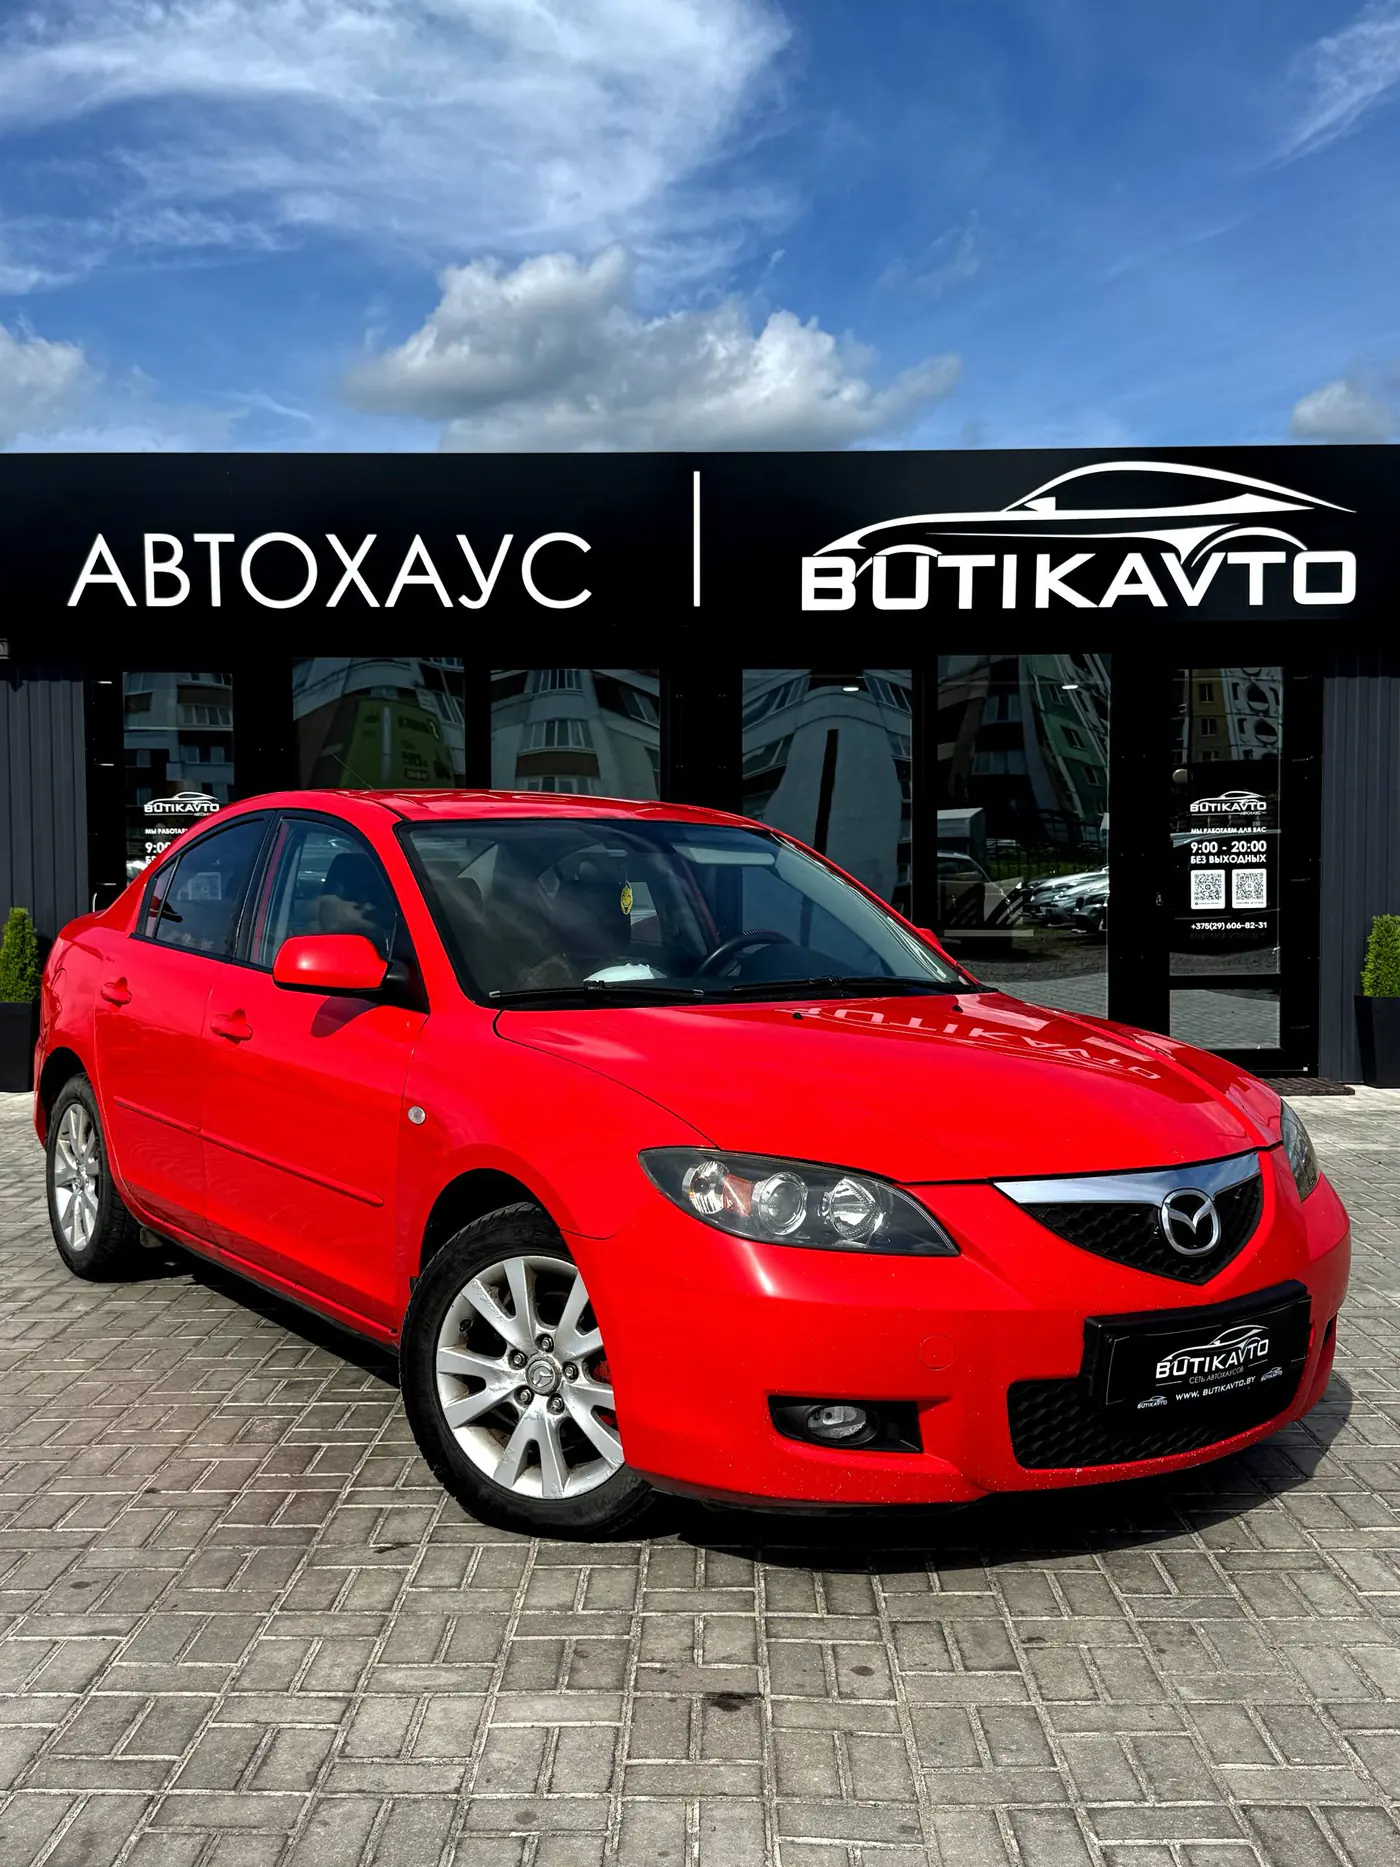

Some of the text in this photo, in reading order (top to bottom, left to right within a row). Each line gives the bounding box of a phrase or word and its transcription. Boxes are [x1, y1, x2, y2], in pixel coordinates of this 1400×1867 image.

[67, 532, 592, 609] АВТОХАУС
[801, 549, 1357, 611] BUTIKAVTO
[144, 803, 220, 813] BUTIKAVTO
[1190, 801, 1267, 812] BUTIKAVTO
[1238, 826, 1252, 834] ДЛЯ
[1190, 841, 1218, 853] 9:00
[1230, 840, 1267, 853] 20:00
[1190, 854, 1267, 864] БЕЗ ВЫХОДНЫХ
[1190, 921, 1267, 931] +375(29) 606-82-31
[1155, 1339, 1269, 1379] BUTIKAVTO
[1188, 1374, 1206, 1384] СЕТЬ
[1202, 1376, 1256, 1396] BUTIKAVTO.BY
